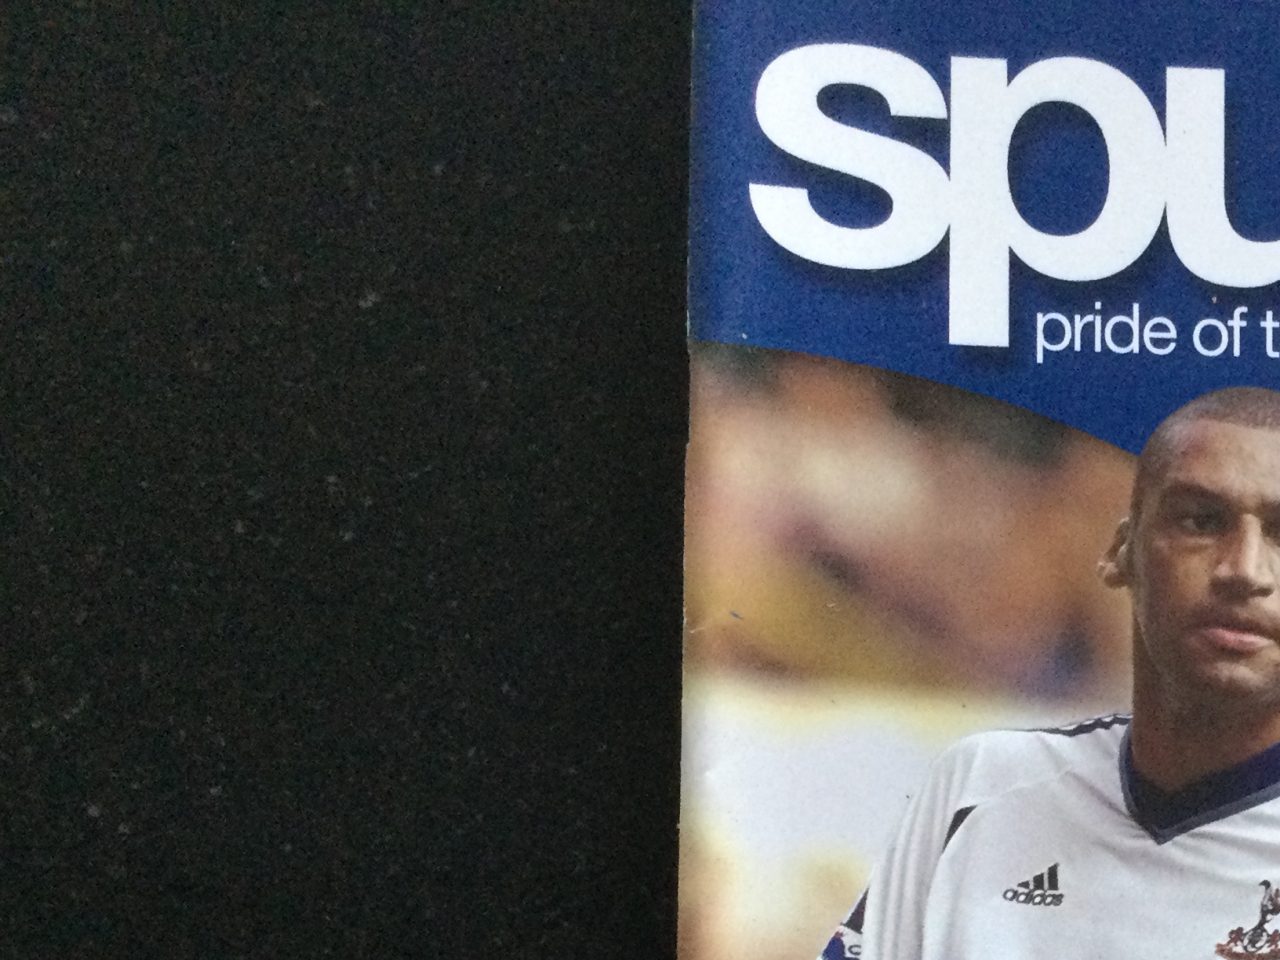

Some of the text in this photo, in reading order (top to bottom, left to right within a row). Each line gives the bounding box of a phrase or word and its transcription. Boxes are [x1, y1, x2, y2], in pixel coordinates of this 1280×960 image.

[1036, 302, 1177, 364] pride
[1192, 306, 1249, 358] of
[1003, 888, 1064, 906] adidas
